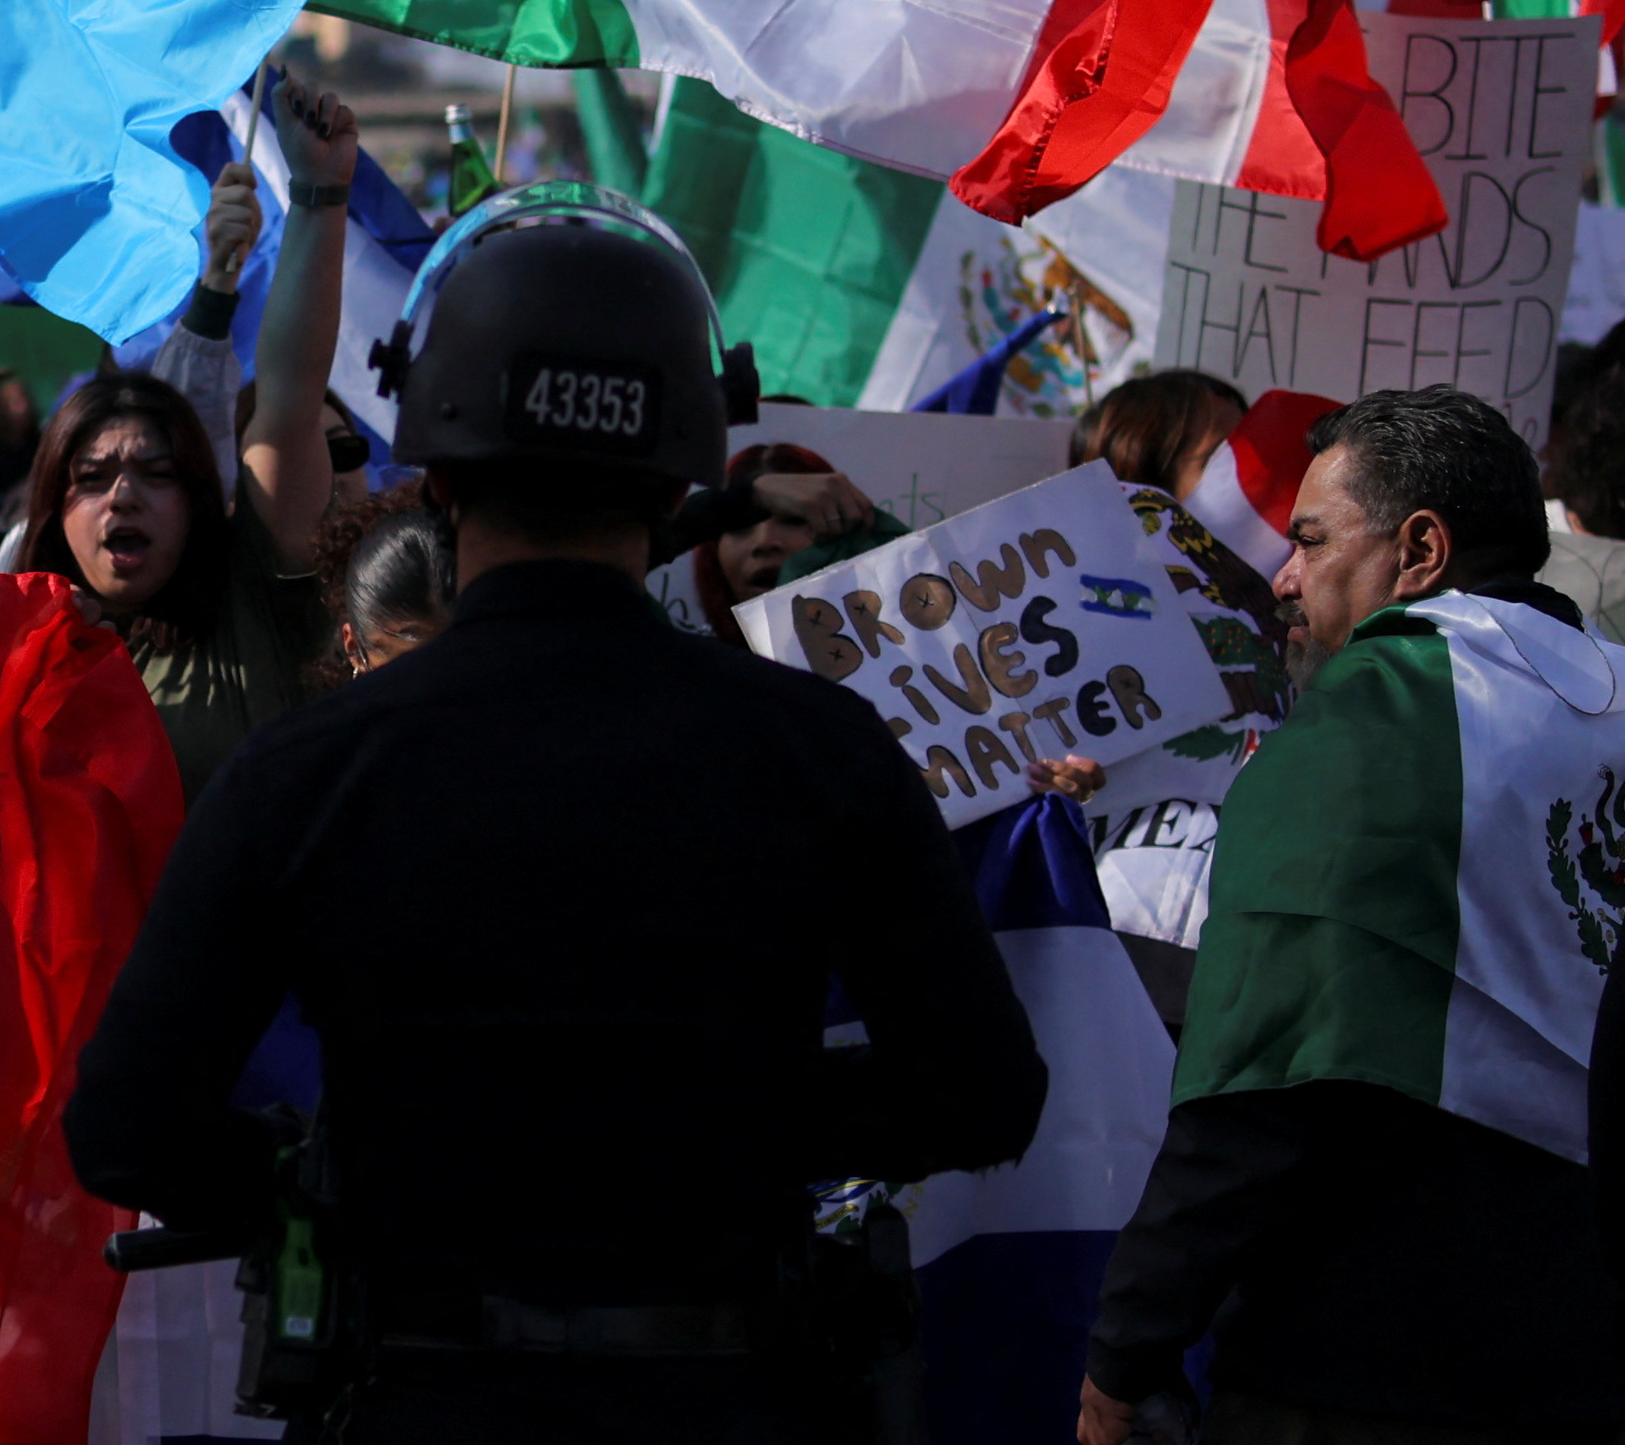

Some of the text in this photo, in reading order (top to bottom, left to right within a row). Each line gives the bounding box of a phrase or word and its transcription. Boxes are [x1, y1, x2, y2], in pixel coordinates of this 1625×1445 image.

[1401, 32, 1576, 161] BITE
[1170, 260, 1554, 402] THAT FEED
[523, 366, 648, 439] 43353
